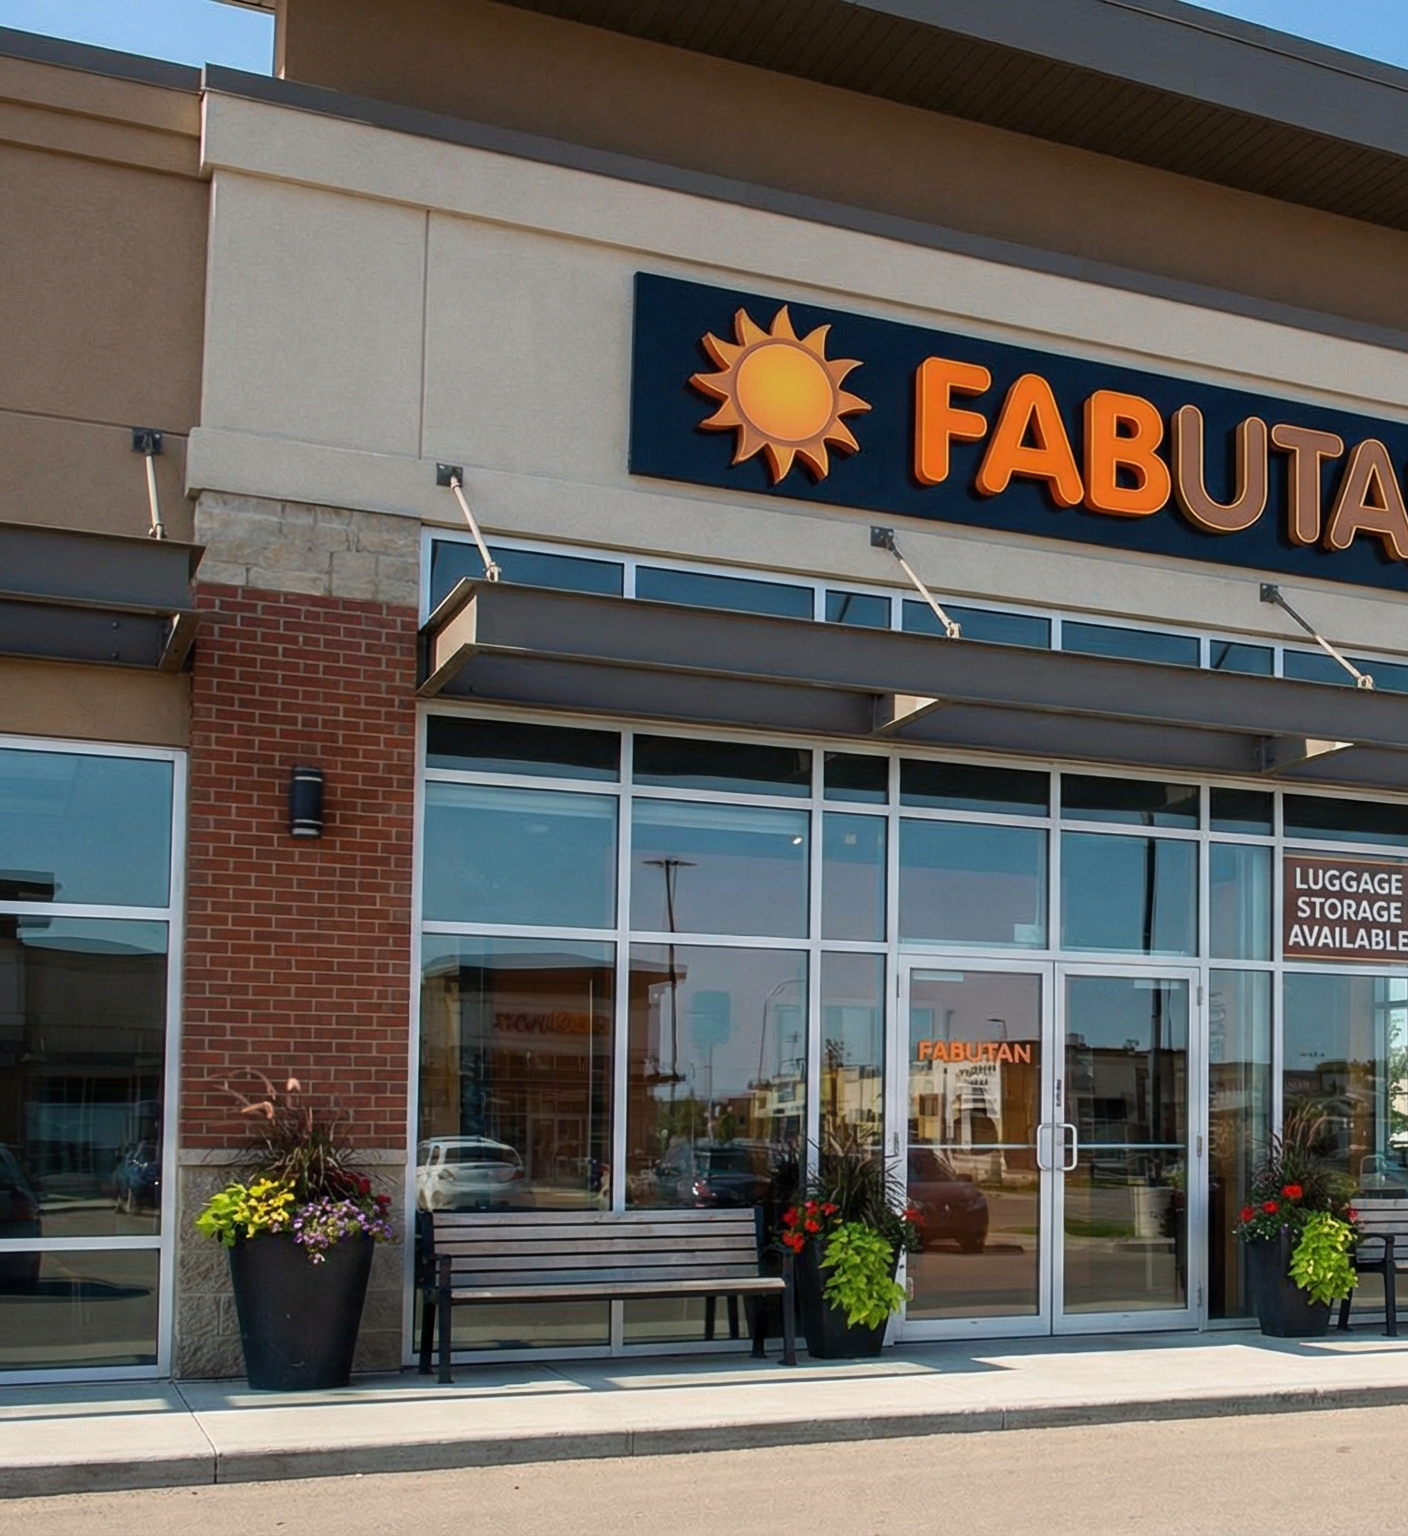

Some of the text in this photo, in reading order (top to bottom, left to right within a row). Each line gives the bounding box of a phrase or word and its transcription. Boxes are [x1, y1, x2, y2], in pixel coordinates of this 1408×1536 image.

[1295, 867, 1403, 895] LUGGAGE
[1297, 896, 1402, 923] STORAGE
[918, 1040, 1031, 1064] FABUTAN
